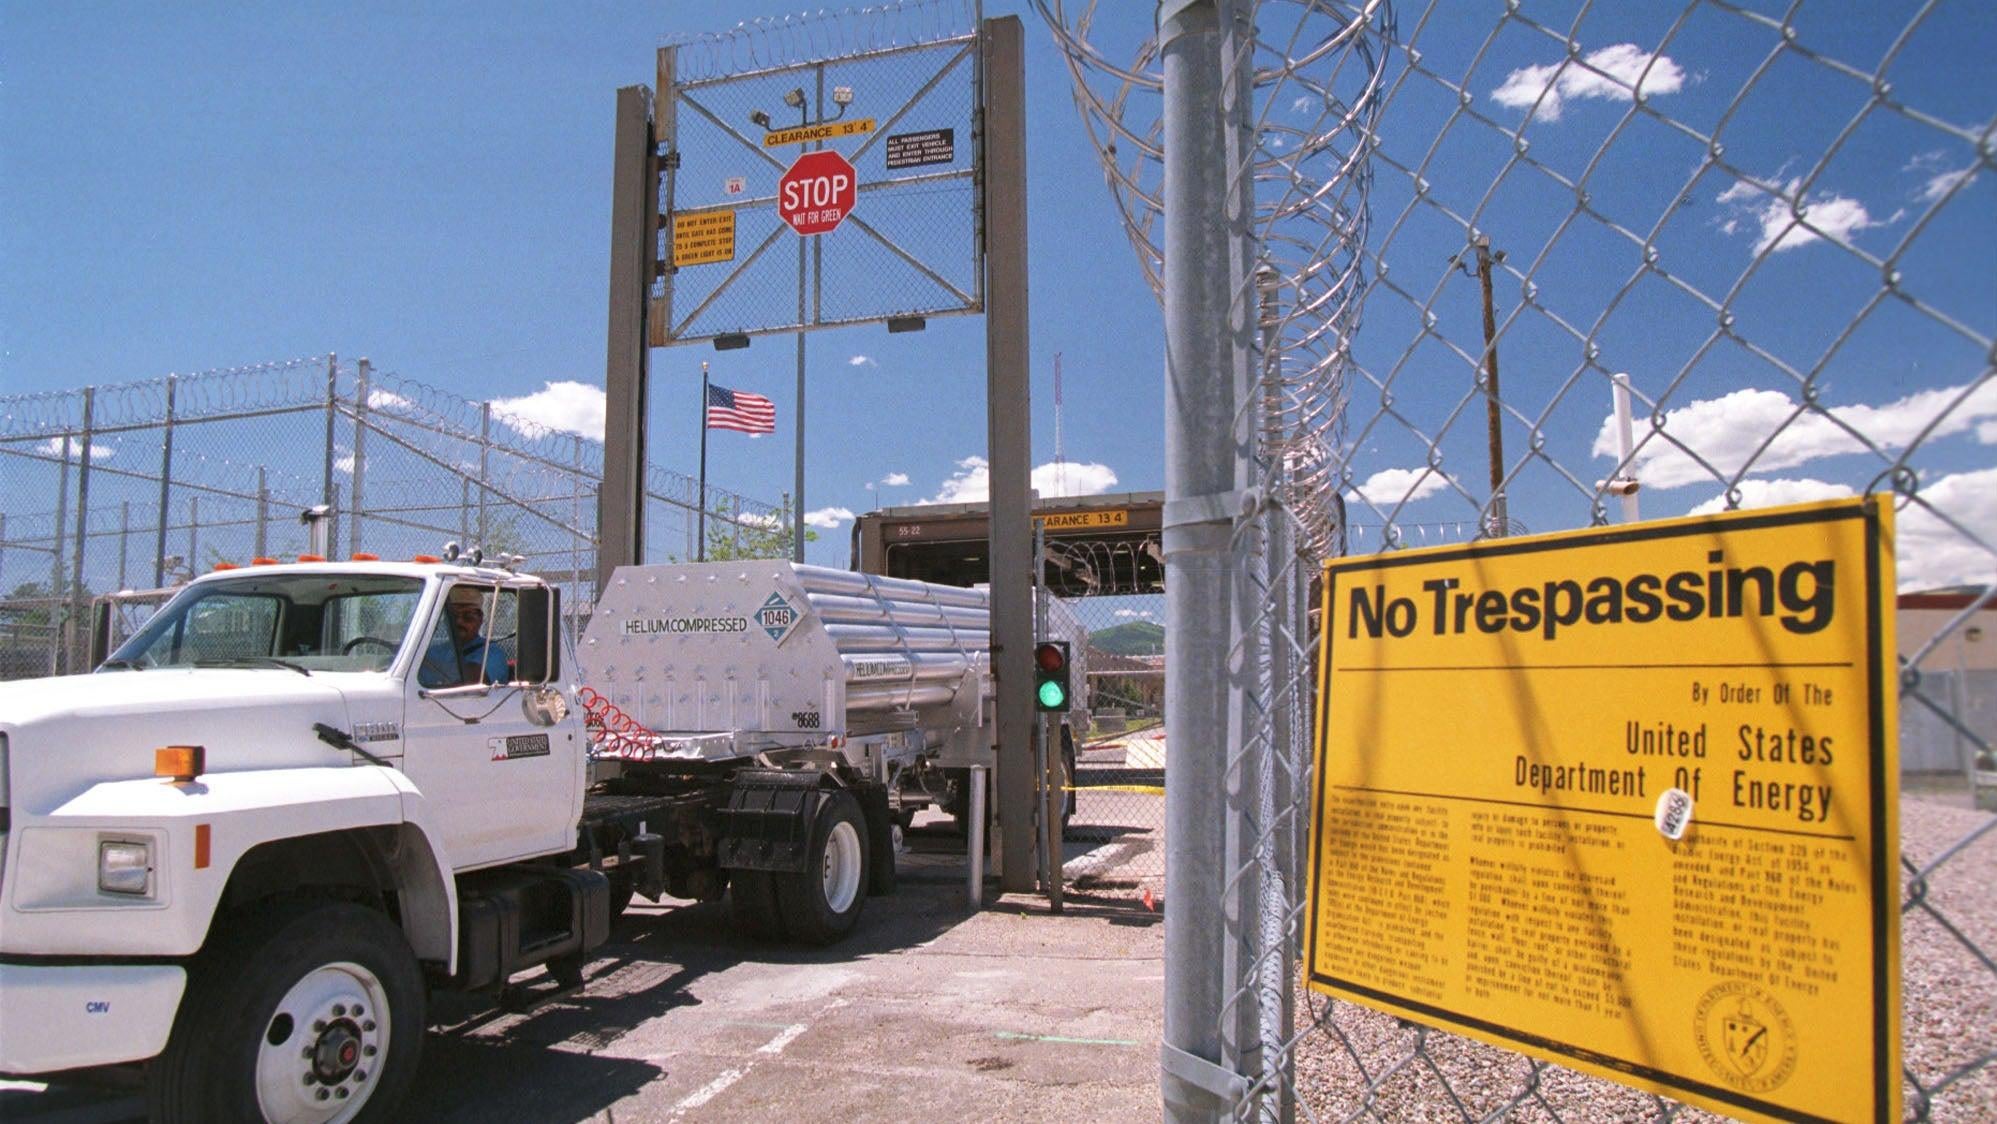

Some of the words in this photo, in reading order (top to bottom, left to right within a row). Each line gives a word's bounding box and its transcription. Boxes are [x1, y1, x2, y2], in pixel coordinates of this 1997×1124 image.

[767, 126, 832, 146] CLEARANCE
[901, 132, 941, 143] PASSENGERS
[922, 140, 946, 148] VEHICLE
[924, 145, 953, 154] THROUGH
[888, 158, 921, 166] PEDESTRIAN
[923, 153, 952, 162] ENTRANCE
[784, 174, 848, 211] STOP
[687, 219, 697, 227] NOT
[793, 211, 806, 226] WAIT
[807, 210, 820, 224] FOR
[821, 208, 841, 223] GREEN
[690, 239, 715, 248] COMPLETE
[719, 237, 732, 245] STOP
[1033, 513, 1089, 529] ARANCE
[1349, 584, 1417, 639] No
[1422, 551, 1836, 641] Trespassing
[763, 610, 789, 626] 1046
[1692, 681, 1709, 704] By
[1720, 682, 1761, 704] Order
[1774, 683, 1790, 704] Of
[1804, 683, 1833, 706] The
[1626, 720, 1706, 758] United
[1738, 724, 1834, 766] States
[1516, 755, 1646, 798] Department
[1675, 767, 1702, 803] Of
[1733, 770, 1833, 823] Energy
[86, 1001, 110, 1013] CMV
